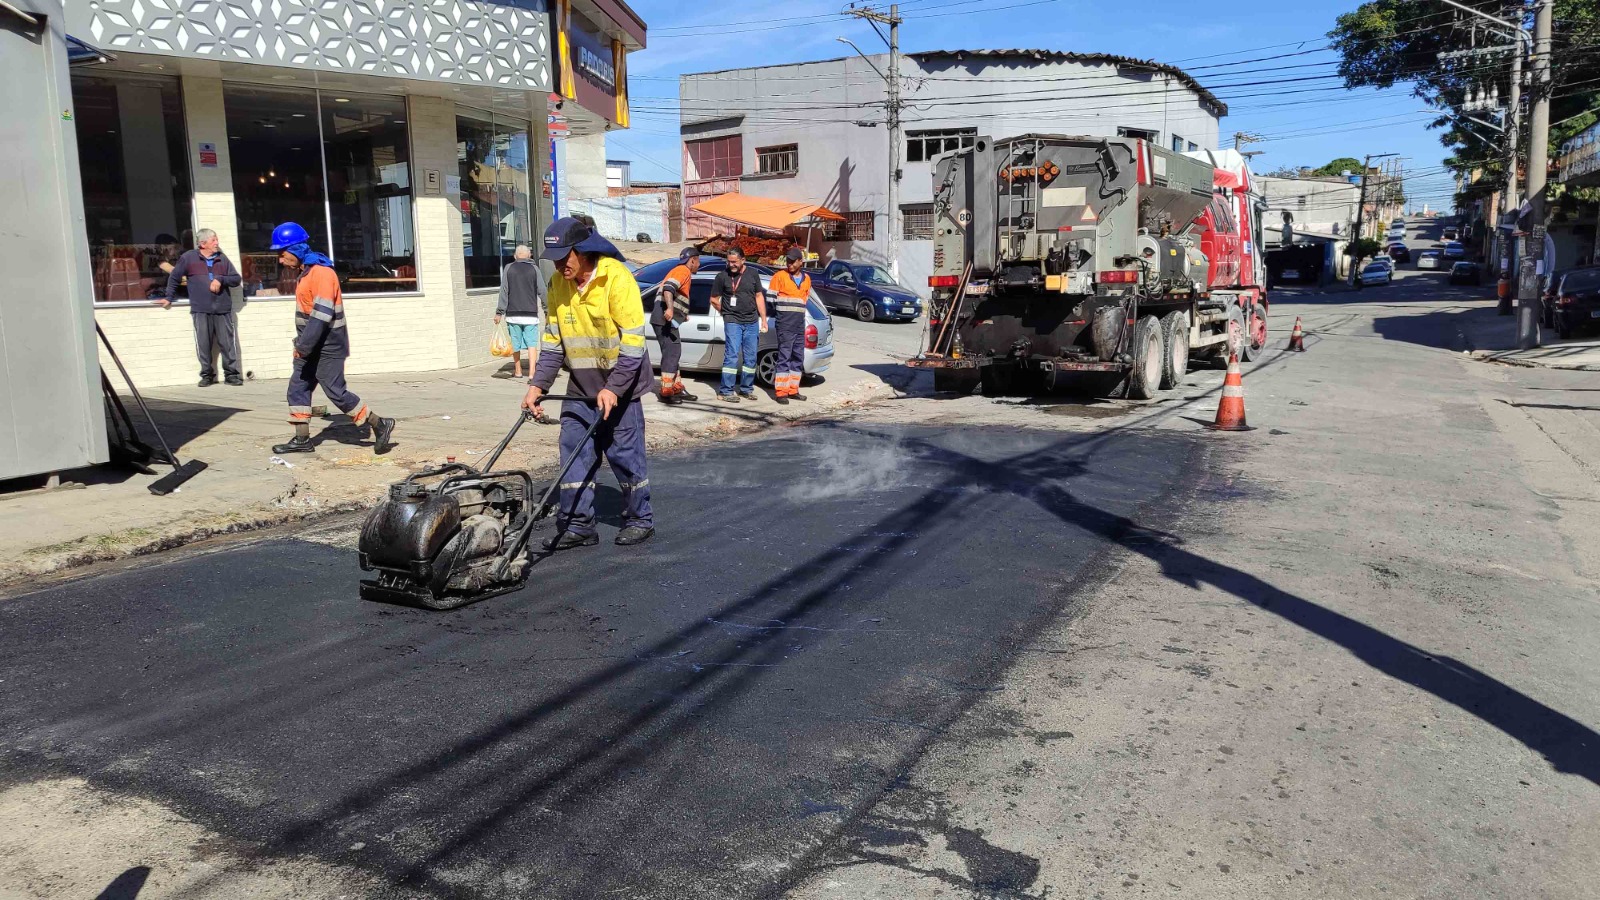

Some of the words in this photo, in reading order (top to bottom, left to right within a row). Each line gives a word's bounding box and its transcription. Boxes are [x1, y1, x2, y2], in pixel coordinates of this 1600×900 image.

[429, 173, 436, 182] E
[558, 169, 566, 217] OGARIAS
[959, 213, 972, 221] 80
